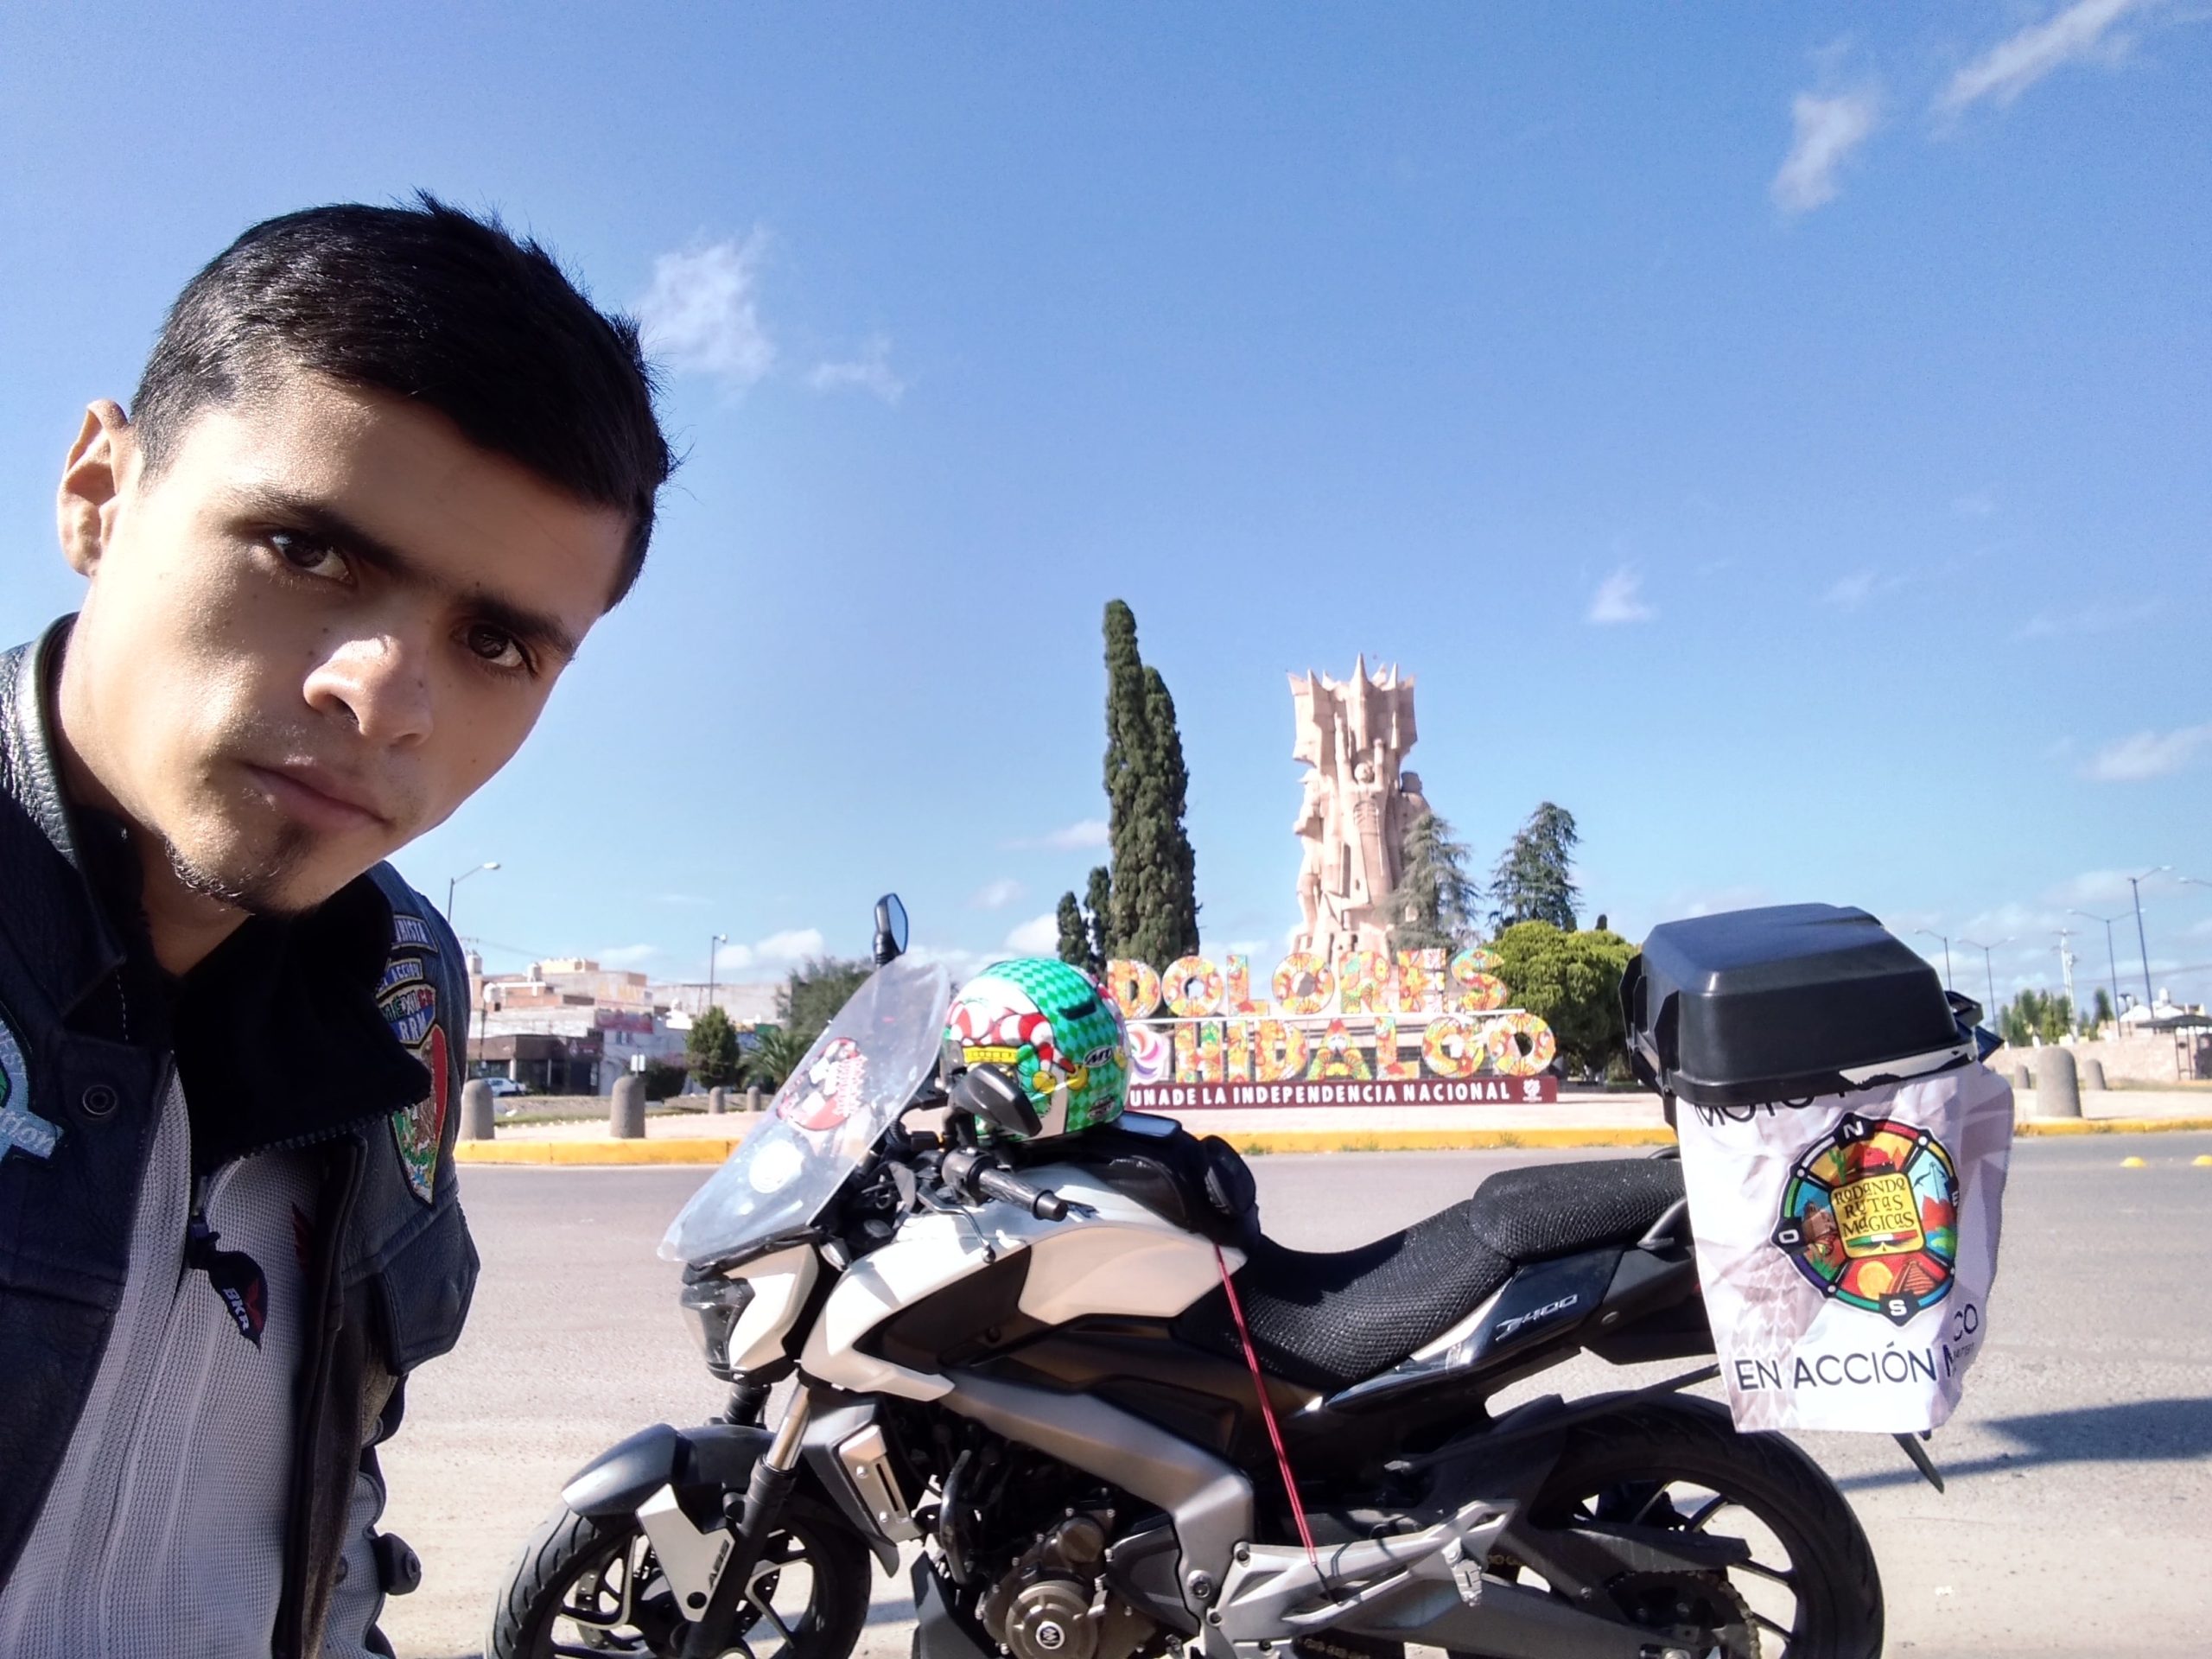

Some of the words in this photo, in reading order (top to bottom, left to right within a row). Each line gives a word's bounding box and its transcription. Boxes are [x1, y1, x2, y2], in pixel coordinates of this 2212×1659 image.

[1107, 948, 1507, 1021] DOLORES
[398, 1011, 427, 1040] RRM
[1174, 1013, 1556, 1084] HIDALGO
[1202, 1086, 1227, 1105] LA
[1232, 1084, 1397, 1105] INDEPENDENCIA
[1402, 1082, 1510, 1103] NACIONAL
[1842, 1121, 1866, 1140] N
[1778, 1229, 1800, 1244] O
[223, 1287, 250, 1332] BKR
[1889, 1299, 1908, 1316] S
[1734, 1359, 1783, 1391] EN
[1793, 1340, 1937, 1389] ACCIÓN
